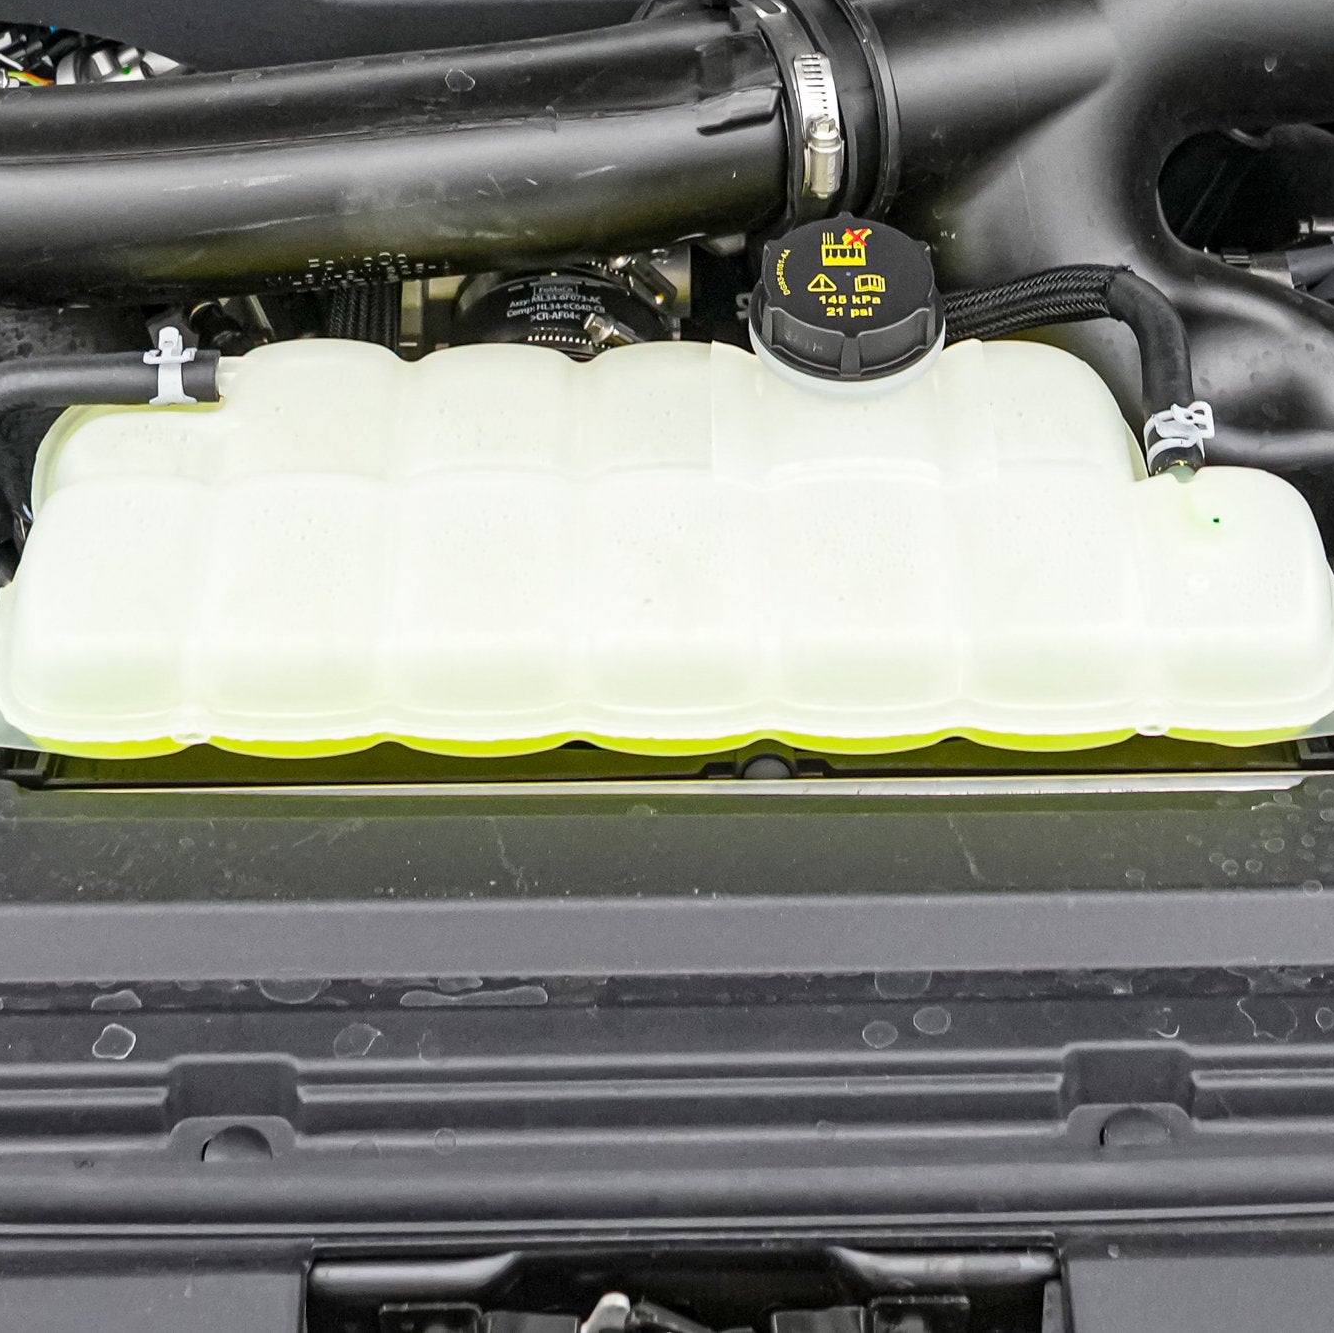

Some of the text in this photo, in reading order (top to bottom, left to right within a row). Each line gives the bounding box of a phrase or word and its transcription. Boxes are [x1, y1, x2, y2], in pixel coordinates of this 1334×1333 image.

[819, 295, 882, 305] 145 kPa
[826, 307, 873, 318] 21 psi
